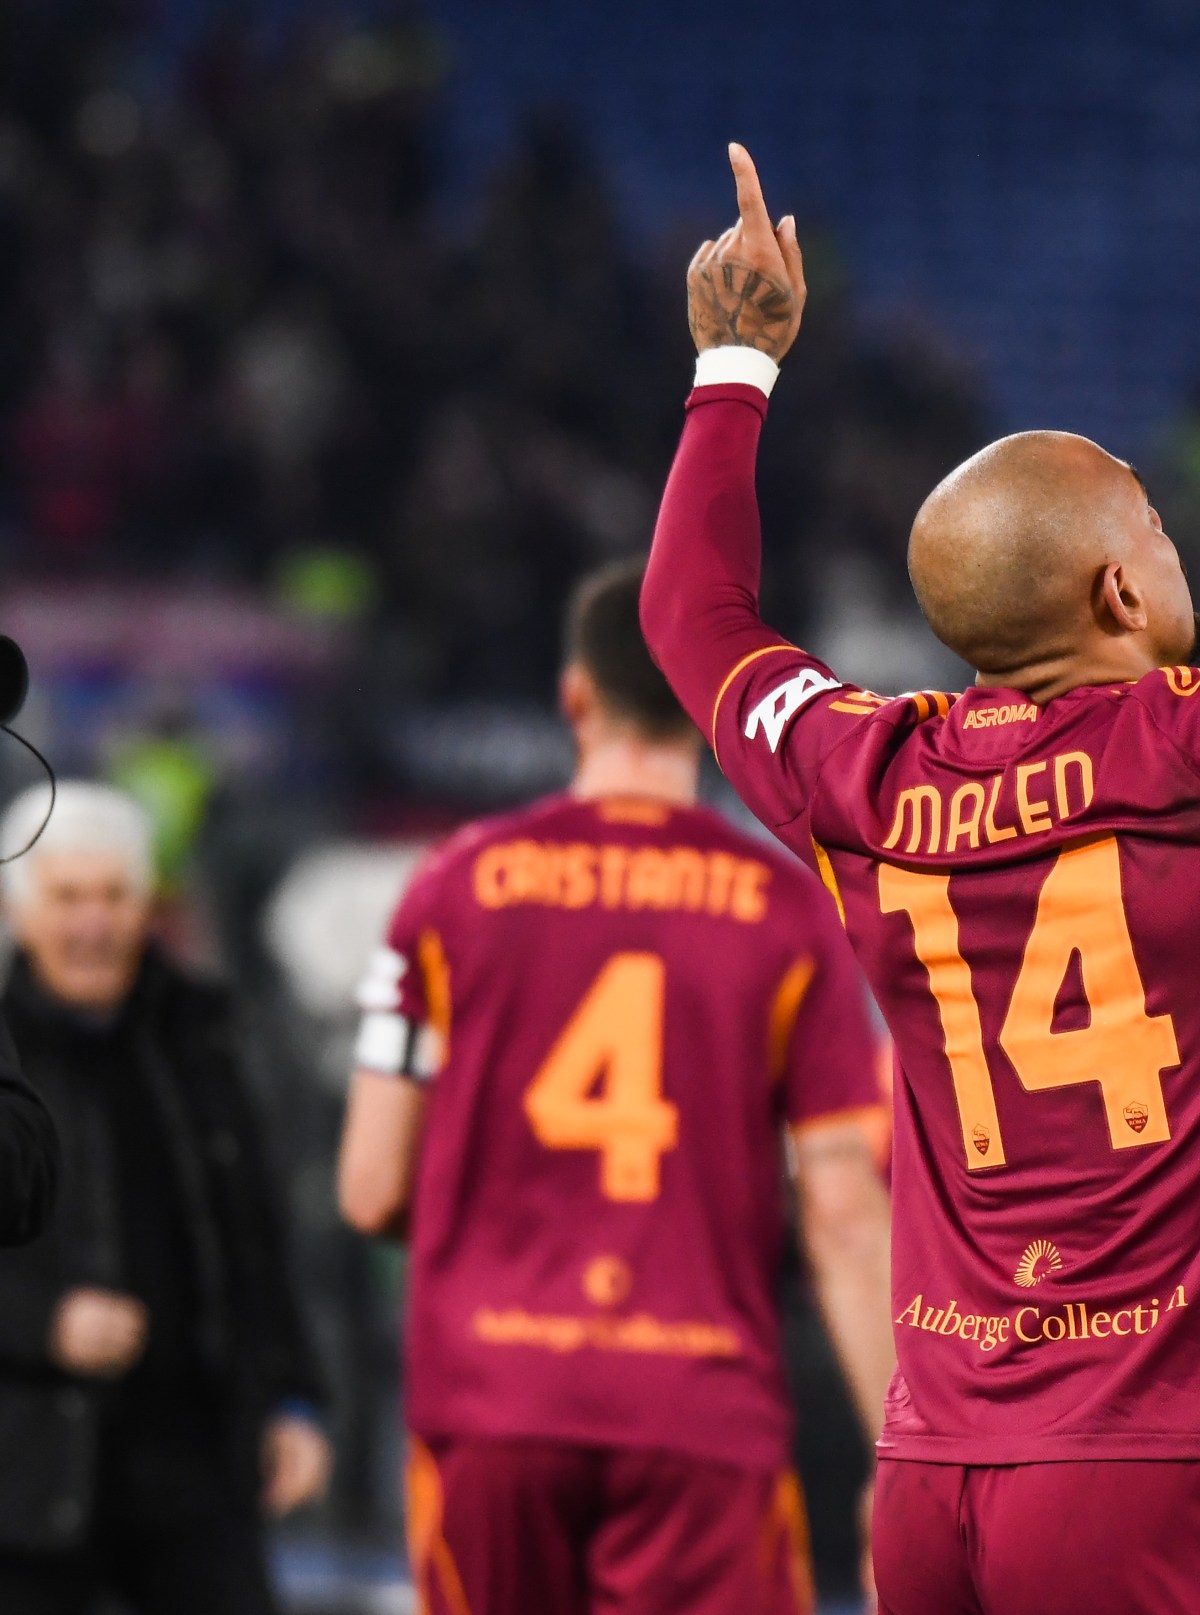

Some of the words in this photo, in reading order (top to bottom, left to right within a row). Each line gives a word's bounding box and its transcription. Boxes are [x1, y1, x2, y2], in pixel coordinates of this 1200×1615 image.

[882, 751, 1094, 855] MALEN
[474, 840, 771, 923] CRISTANTE
[877, 829, 1182, 1171] 14
[524, 952, 679, 1202] 4
[895, 1294, 1010, 1352] Auberge
[1014, 1284, 1189, 1344] Collectin
